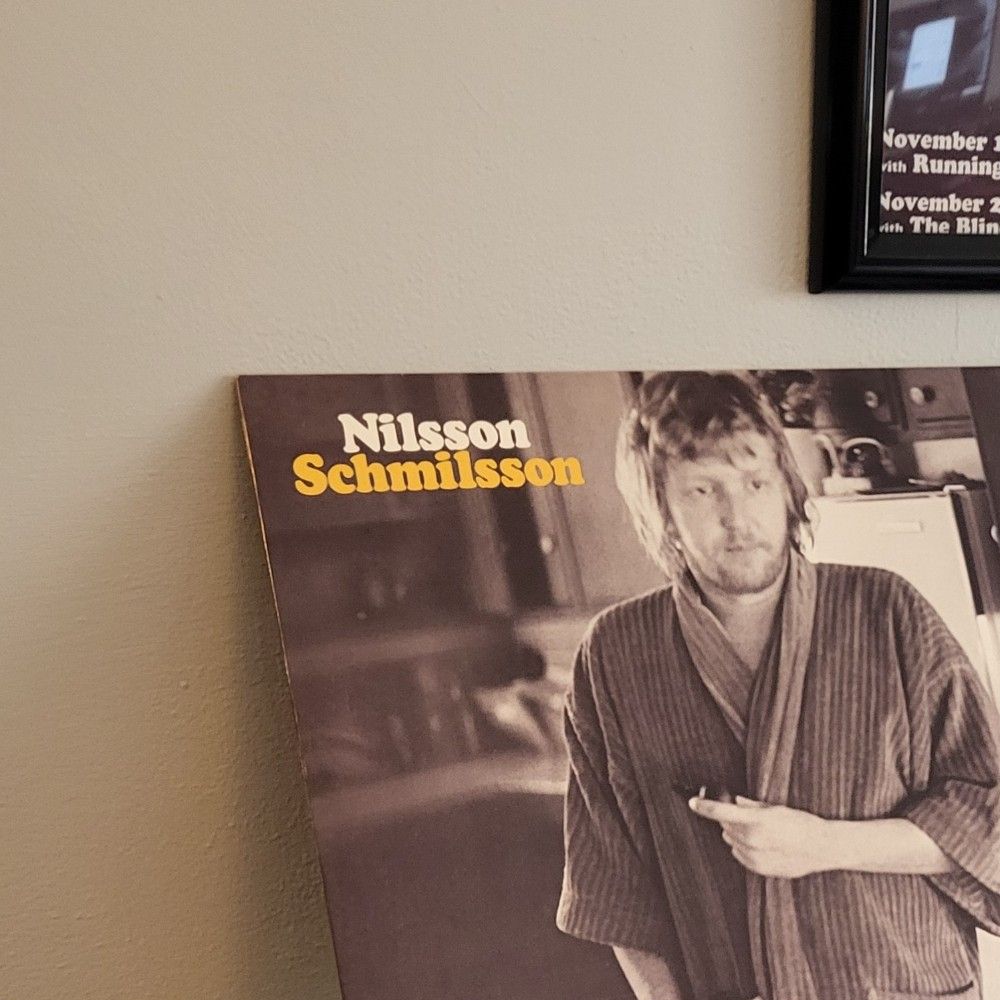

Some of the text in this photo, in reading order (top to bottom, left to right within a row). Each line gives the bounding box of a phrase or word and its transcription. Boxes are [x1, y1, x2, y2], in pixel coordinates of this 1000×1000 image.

[909, 216, 950, 235] The
[336, 412, 532, 453] Nilsson
[292, 450, 586, 496] Schmilsson
